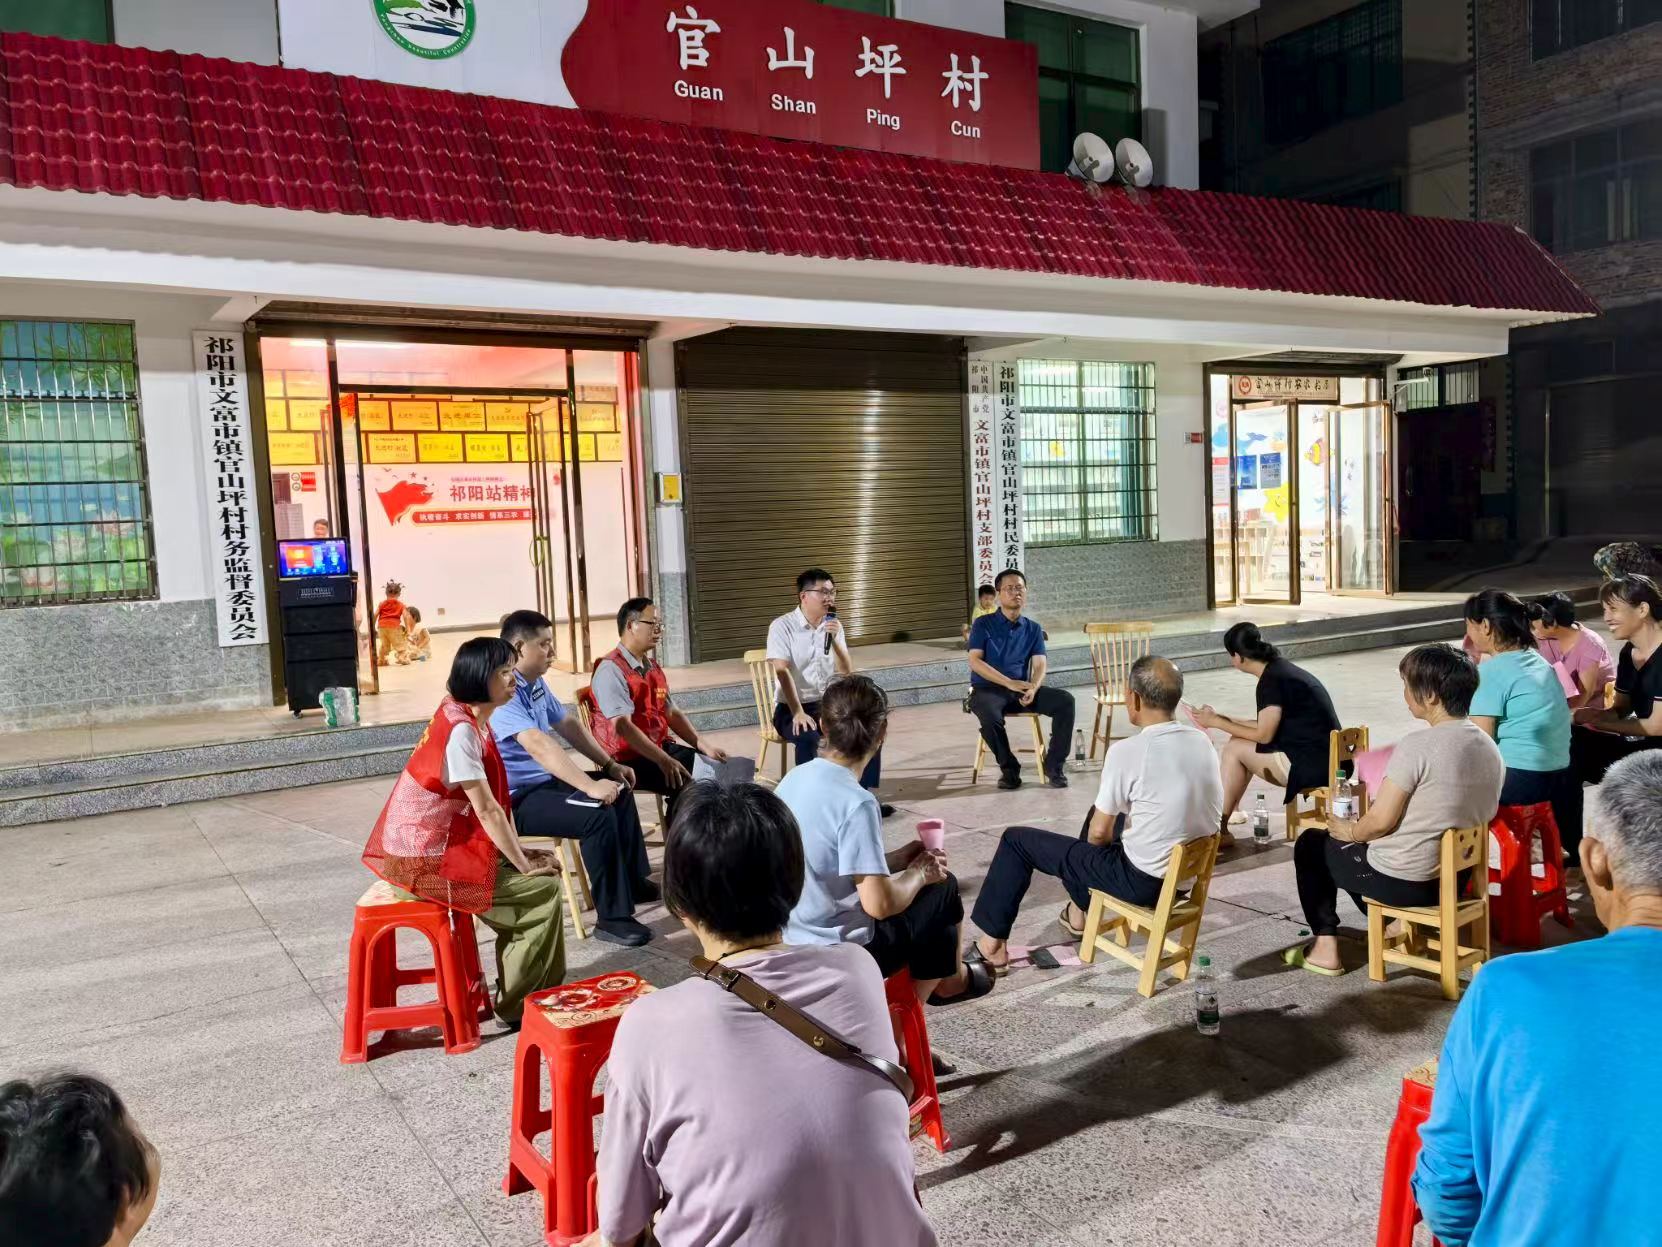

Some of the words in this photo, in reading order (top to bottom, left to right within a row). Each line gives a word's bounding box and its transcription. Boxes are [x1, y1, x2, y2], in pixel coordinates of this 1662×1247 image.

[666, 5, 989, 112] 官山坪村
[674, 79, 723, 101] Guan
[771, 93, 817, 114] Shan
[866, 109, 900, 130] Ping
[951, 121, 981, 139] Cun
[204, 337, 257, 640] 祁阳市文富市镇官山坪村村务监督委员会
[974, 419, 994, 585] 文富市镇官山坪村支部委员会
